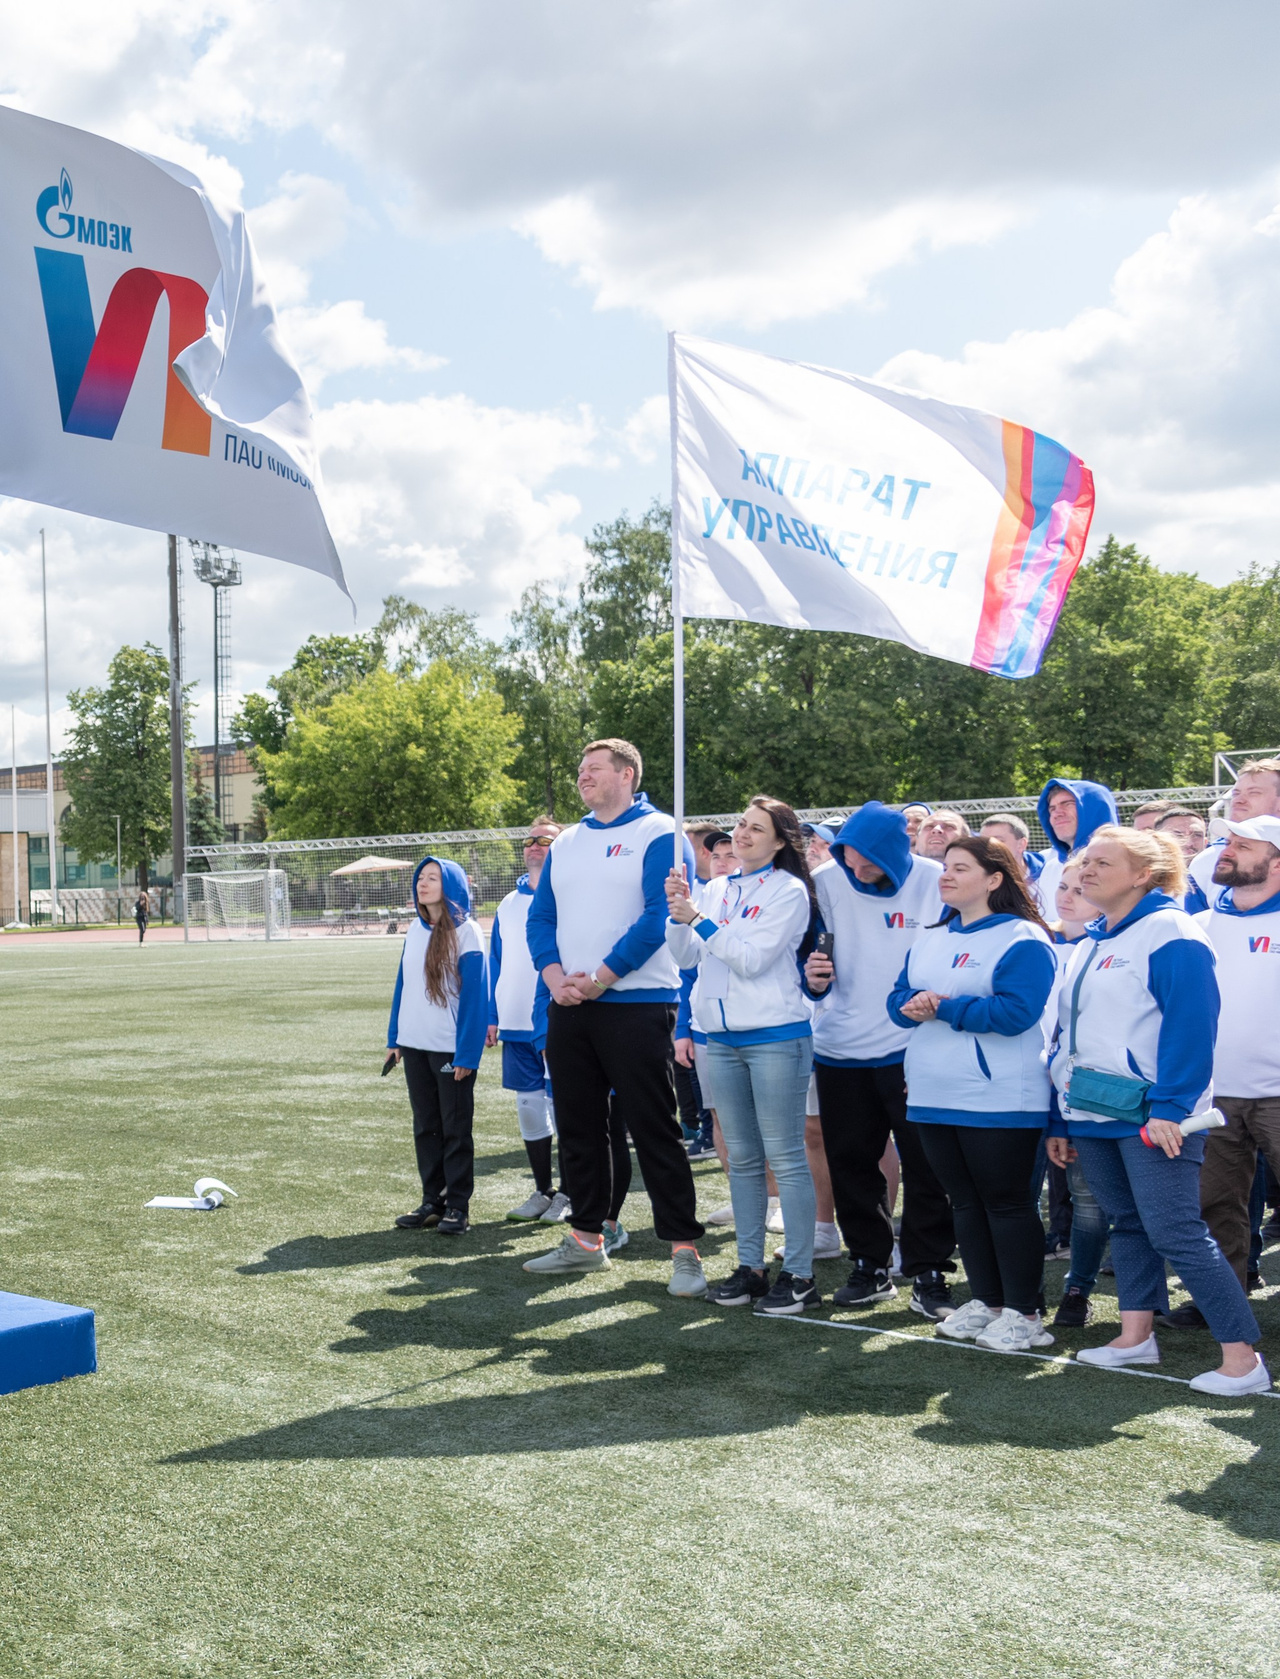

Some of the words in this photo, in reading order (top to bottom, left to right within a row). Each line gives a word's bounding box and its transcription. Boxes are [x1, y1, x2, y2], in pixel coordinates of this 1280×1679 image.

[77, 216, 133, 254] МОЭК
[738, 449, 931, 520] АППАРАТ
[702, 497, 958, 589] УПРАВЛЕНИЯ
